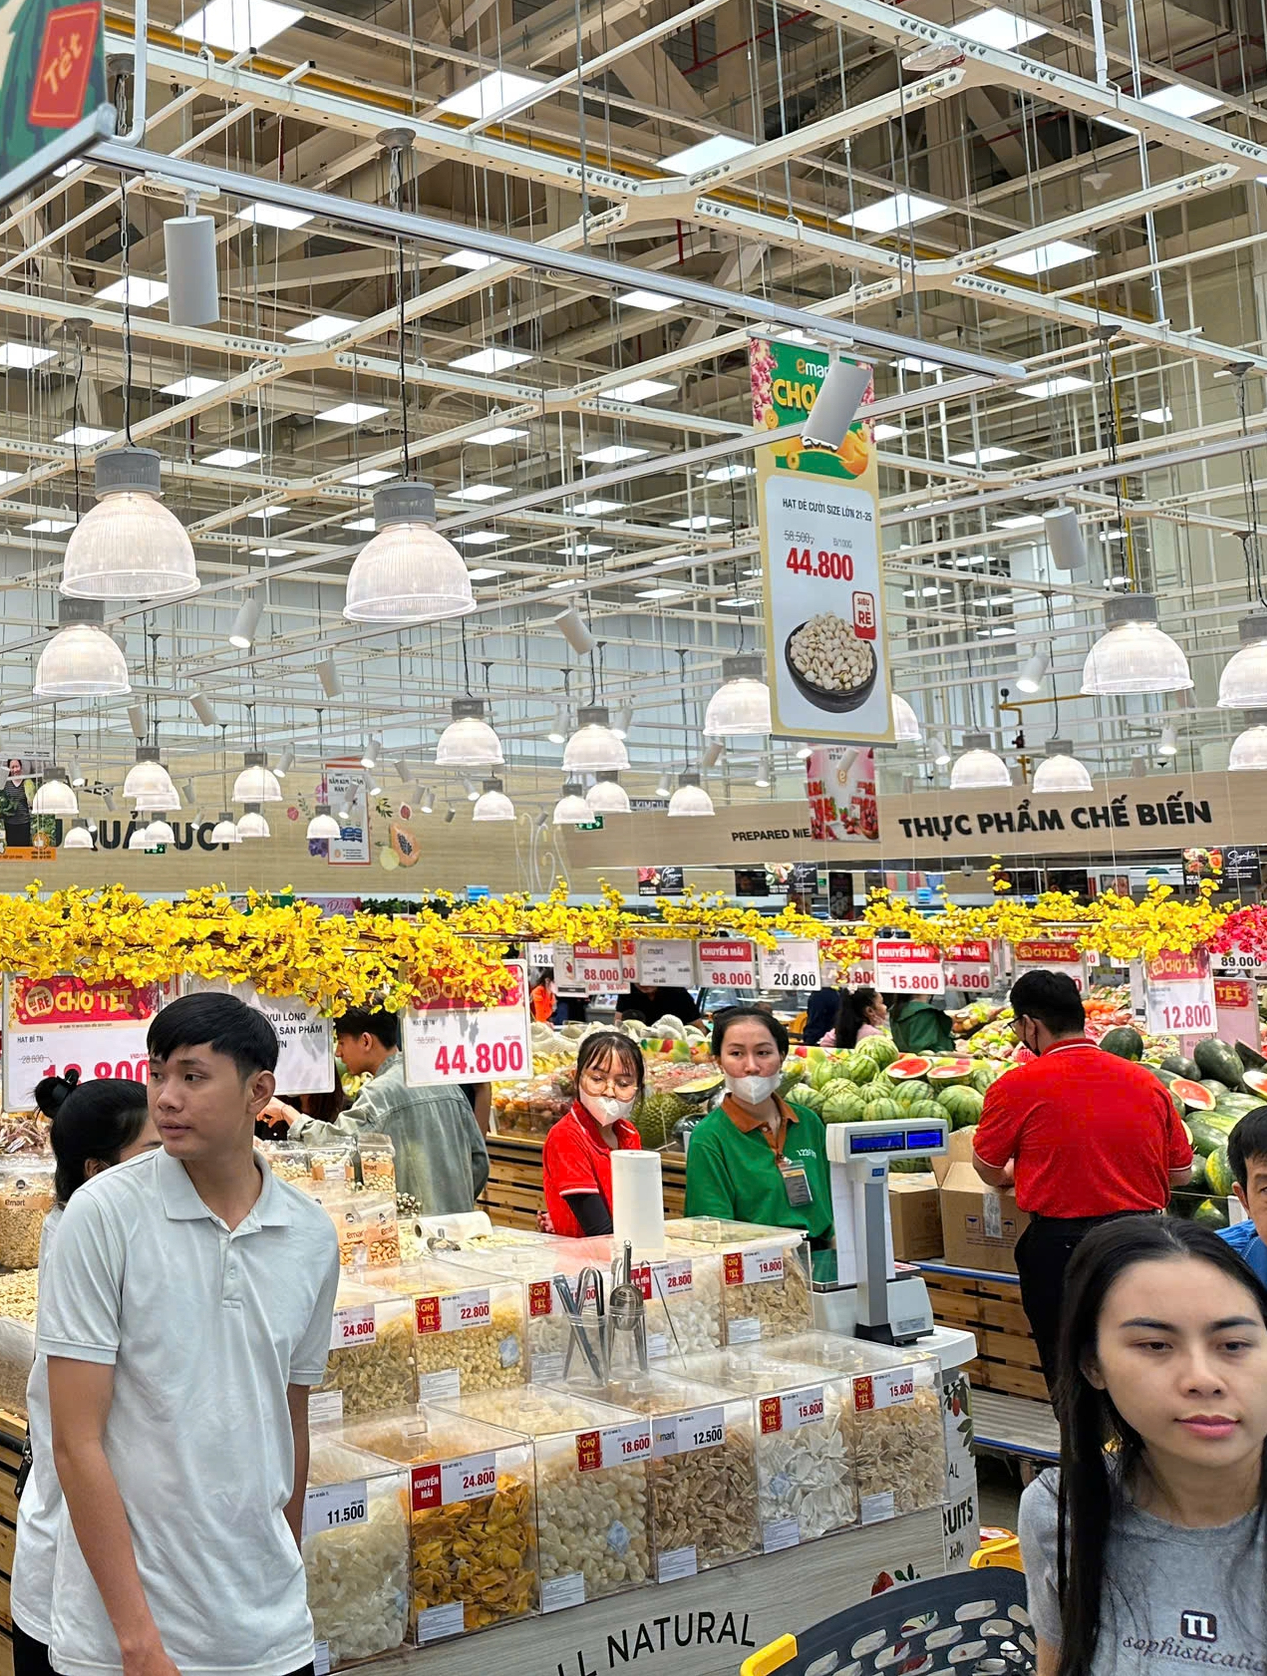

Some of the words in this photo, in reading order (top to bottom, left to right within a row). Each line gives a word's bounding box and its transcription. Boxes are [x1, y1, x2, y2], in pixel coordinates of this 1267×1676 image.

[43, 32, 85, 95] Tết
[826, 505, 841, 517] SIZE
[786, 547, 854, 581] 44.800
[899, 814, 972, 841] THỰC
[977, 800, 1065, 835] PHẨM
[1071, 794, 1130, 829] CHẾ
[1136, 791, 1212, 826] BIẾN
[732, 828, 790, 842] PREPARED
[701, 947, 730, 956] KHUYẾN
[877, 945, 911, 958] KHUYẾN
[913, 946, 930, 958] MÃI
[1221, 955, 1262, 967] 89.000
[584, 968, 619, 981] 88.000
[712, 972, 752, 985] 98.000
[774, 973, 816, 987] 20.800
[891, 975, 939, 989] 15.800
[55, 991, 94, 1014] CHỢ
[283, 1011, 307, 1022] LÒNG
[1163, 1004, 1211, 1029] 12.800
[279, 1023, 296, 1035] SẢN
[298, 1022, 323, 1035] PHẨM
[435, 1042, 523, 1076] 44.800
[759, 1260, 782, 1273] 19.800
[667, 1275, 692, 1288] 28.800
[460, 1305, 489, 1320] 22.800
[343, 1322, 374, 1337] 24.800
[889, 1383, 913, 1398] 15.800
[798, 1402, 824, 1418] 15.800
[693, 1428, 723, 1445] 12.500
[621, 1437, 650, 1454] 18.600
[414, 1474, 439, 1490] KHUYẾN
[462, 1471, 495, 1489] 24.800
[420, 1488, 434, 1500] MÃI
[327, 1504, 364, 1524] 11.500
[1183, 1613, 1215, 1639] TL
[608, 1611, 755, 1668] NATURAL
